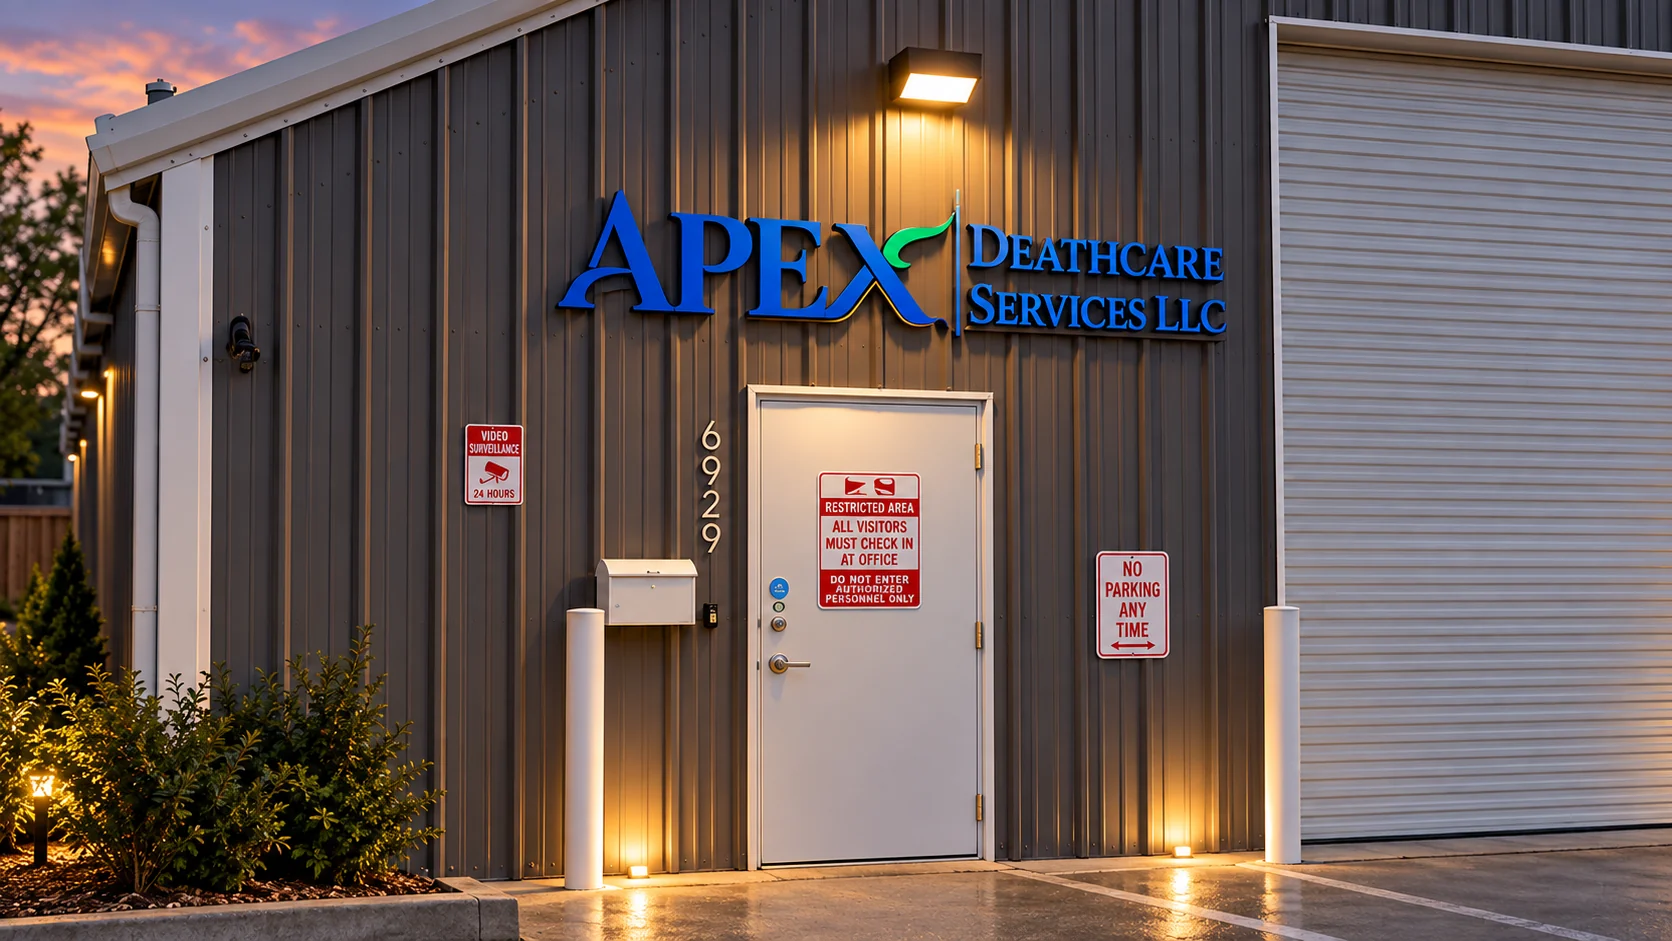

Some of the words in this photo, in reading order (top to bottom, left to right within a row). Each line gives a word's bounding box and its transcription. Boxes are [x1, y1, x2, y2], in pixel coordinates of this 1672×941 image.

[968, 223, 1225, 281] DEATHCARE
[557, 190, 955, 329] APEX
[969, 283, 1147, 331] SERVICES
[1154, 295, 1228, 334] LLC
[481, 430, 508, 441] VIDEO
[469, 443, 519, 454] SURVEILLANCE
[473, 489, 484, 498] 24
[487, 489, 515, 498] HOURS
[701, 420, 721, 554] 6929
[825, 502, 885, 513] RESTRICTED
[888, 502, 914, 513] AREA
[832, 520, 853, 533] ALL
[857, 520, 907, 533] VISITORS
[825, 537, 857, 550] MUST
[860, 537, 898, 550] CHECK
[901, 537, 914, 550] IN
[841, 553, 855, 566] AT
[858, 553, 898, 566] OFFICE
[1122, 561, 1142, 577] NO
[830, 575, 845, 584] DO
[849, 575, 871, 584] NOT
[875, 575, 909, 584] ENTER
[835, 585, 903, 593] AUTHORIZED
[1105, 582, 1160, 597] PARKING
[825, 594, 885, 603] PERSONNEL
[888, 594, 915, 603] ONLY
[1119, 602, 1147, 618] ANY
[1116, 622, 1149, 638] TIME
